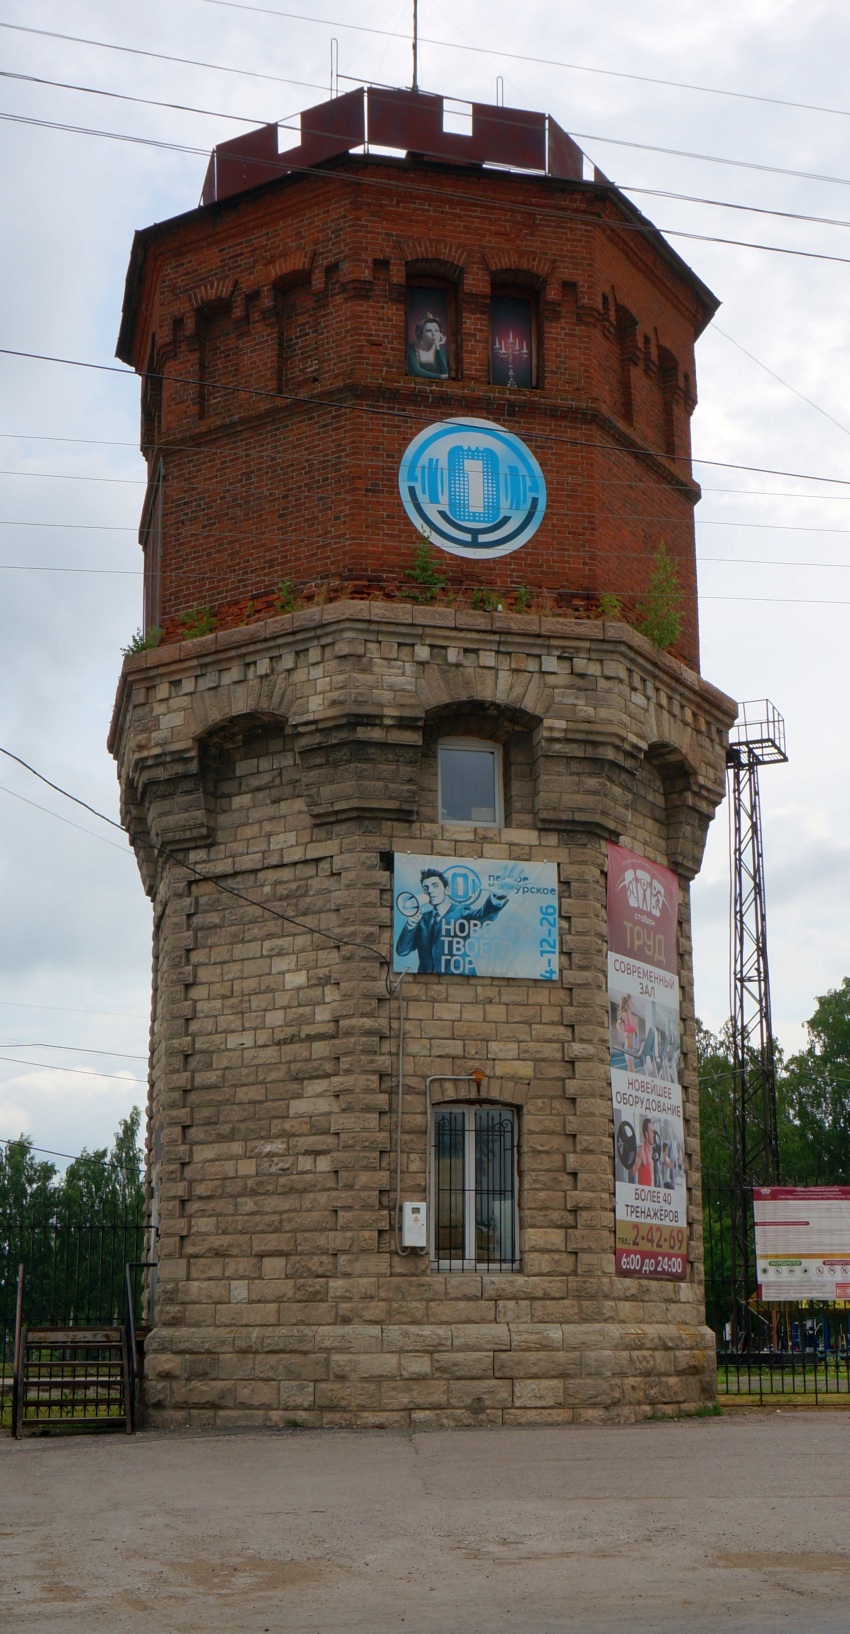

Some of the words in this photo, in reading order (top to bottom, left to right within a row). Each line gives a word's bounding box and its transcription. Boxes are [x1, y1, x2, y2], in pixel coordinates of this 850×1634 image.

[540, 904, 557, 981] 4-12-26
[623, 921, 666, 965] ТРУД
[613, 959, 675, 991] СОВРЕМЕННЫЙ
[639, 982, 656, 999] ЗАЛ
[627, 1077, 672, 1100] НОВЕЙШЕЕ
[615, 1091, 681, 1118] ОБОРУДОВАНИЕ
[634, 1188, 662, 1205] БОЛЕЕ
[662, 1192, 672, 1206] 40
[624, 1204, 679, 1223] ТРЕНАЖЁРОВ
[632, 1223, 684, 1251] 2-42-69
[621, 1253, 641, 1270] 6:00
[642, 1257, 656, 1274] до
[656, 1256, 683, 1273] 24:00
